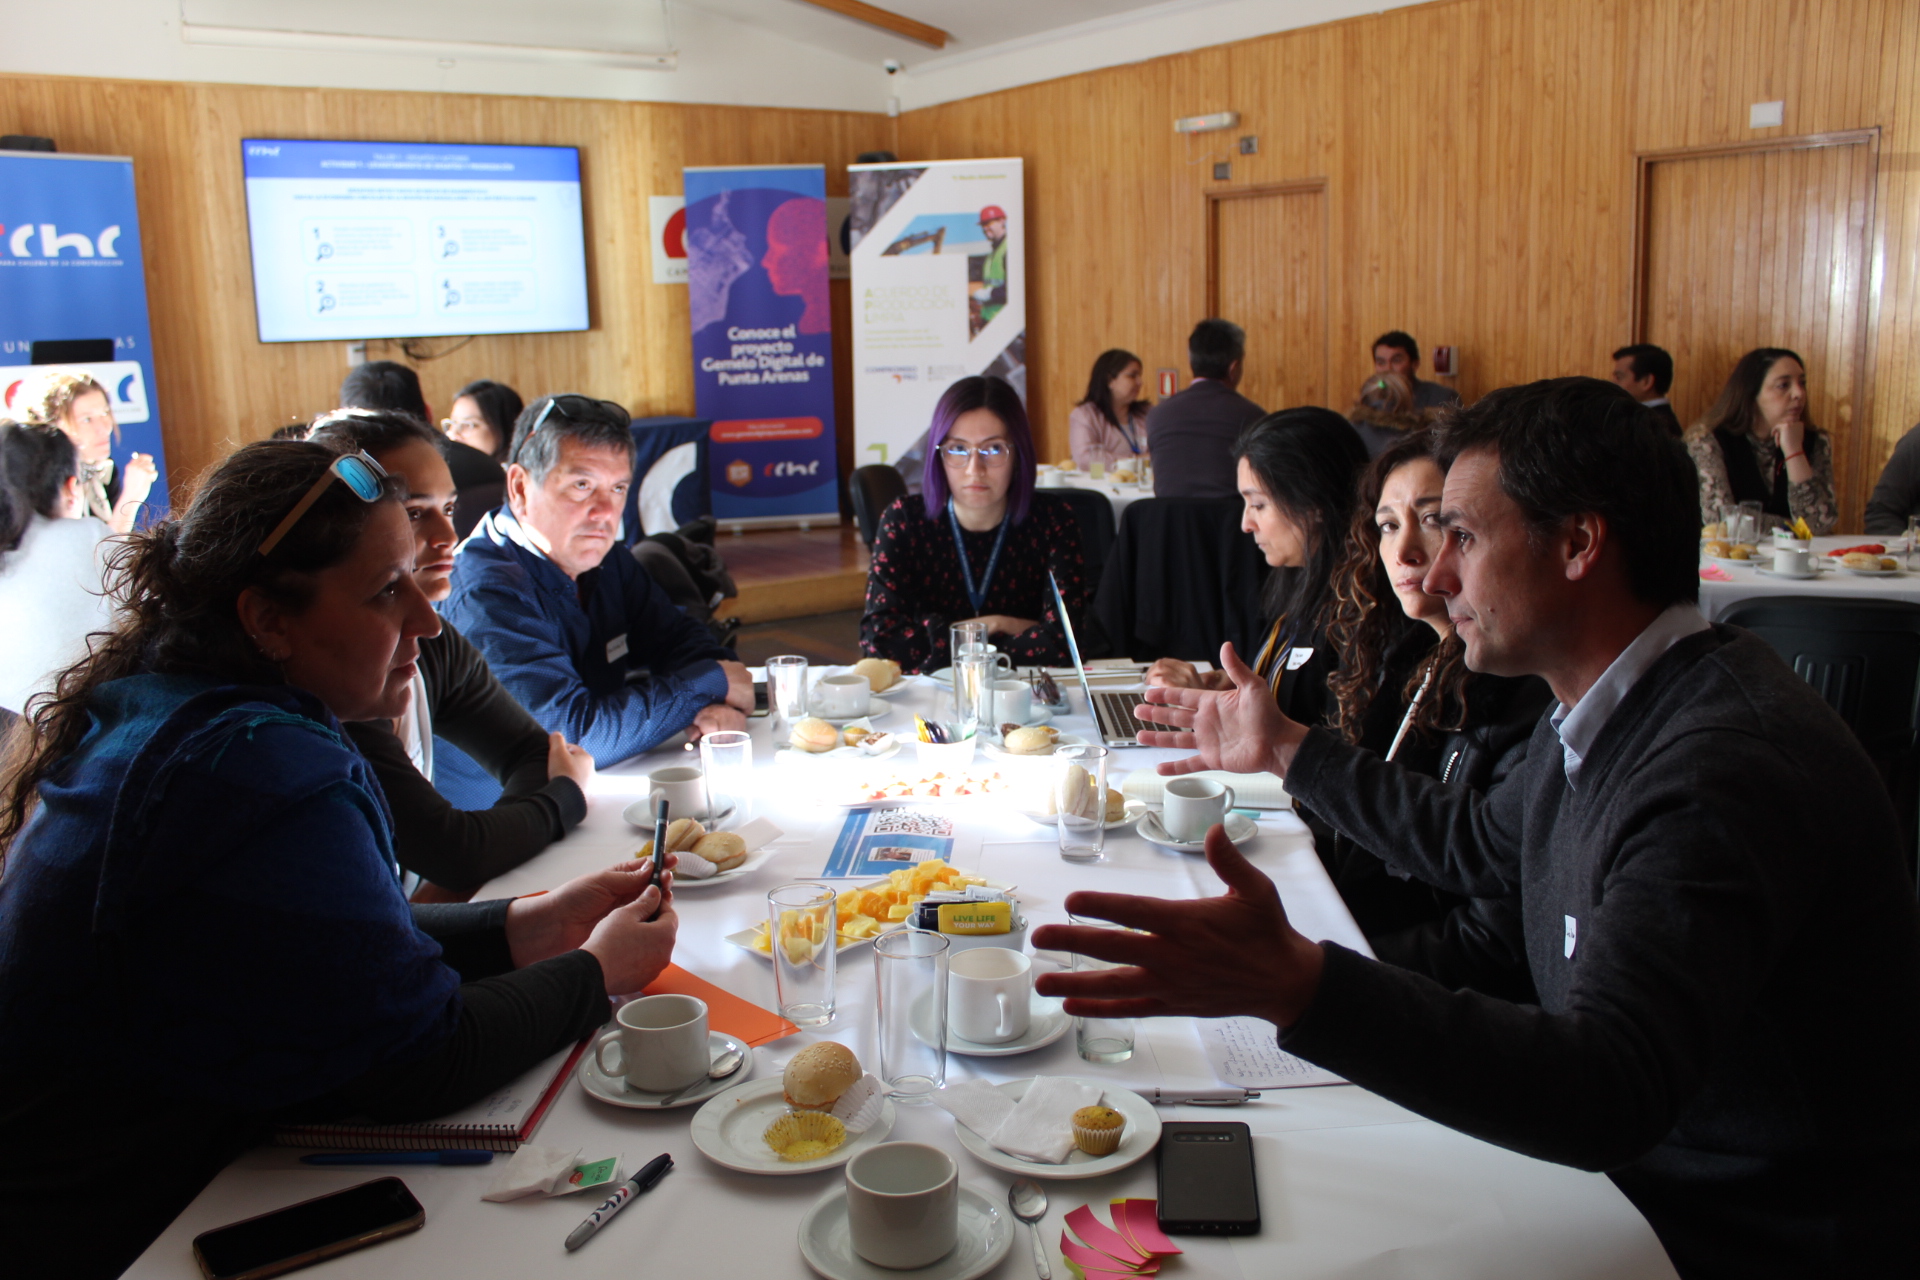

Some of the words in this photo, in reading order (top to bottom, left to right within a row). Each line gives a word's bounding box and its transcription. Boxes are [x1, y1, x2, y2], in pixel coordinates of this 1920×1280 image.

[727, 326, 781, 341] Conoce
[782, 323, 797, 339] el
[731, 341, 794, 359] proyecto
[701, 356, 758, 372] Gemelo
[759, 353, 805, 372] Digital
[806, 352, 825, 367] de
[718, 371, 760, 386] Punta
[761, 369, 810, 384] Arenas
